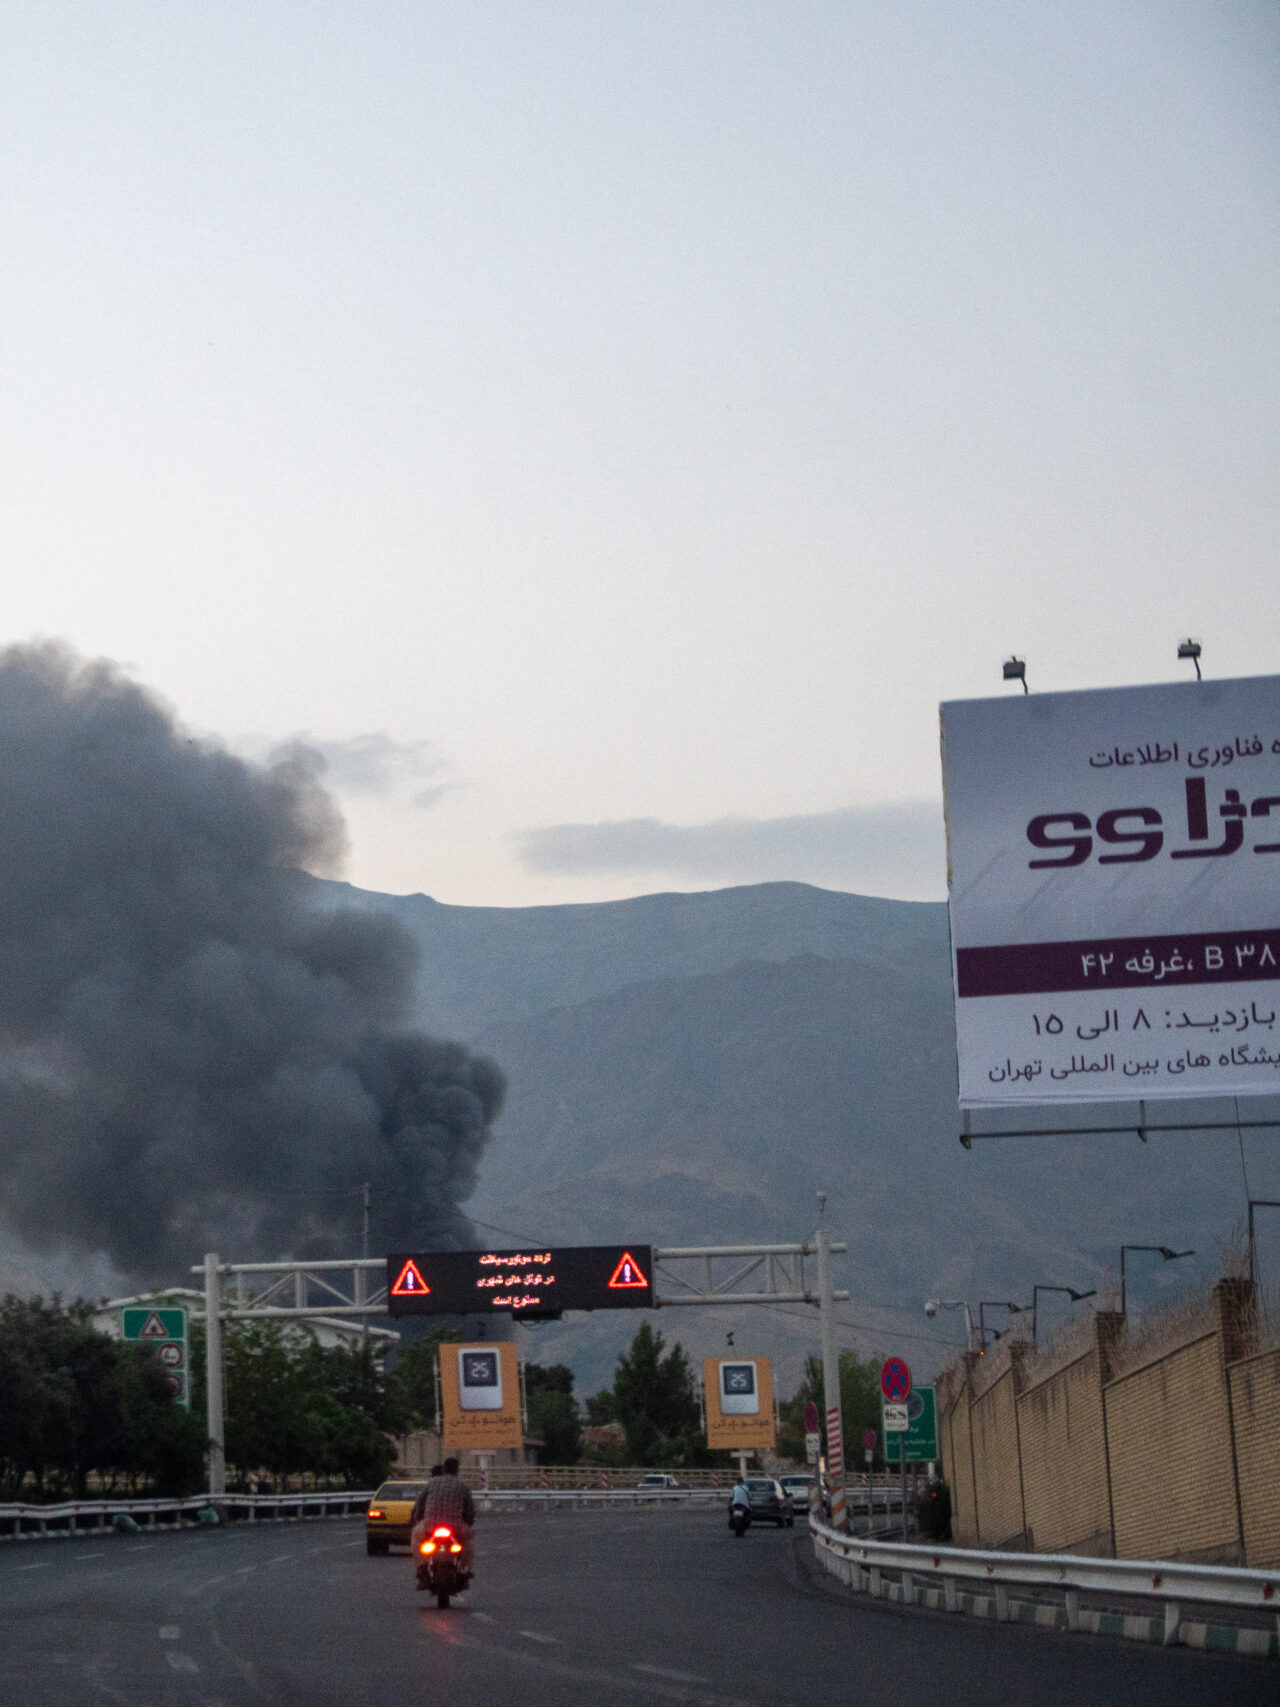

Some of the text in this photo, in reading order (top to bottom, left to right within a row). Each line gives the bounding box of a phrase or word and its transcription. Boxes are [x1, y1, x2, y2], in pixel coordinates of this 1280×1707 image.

[1089, 741, 1179, 768] اطلاعات
[1187, 734, 1264, 769] فناوری
[1081, 952, 1114, 977] ۴۲
[1204, 945, 1224, 970] B
[1032, 1001, 1276, 1040] بازدید: ۸ الی ۱۵
[989, 1058, 1042, 1082] تهران
[1050, 1053, 1115, 1080] المللی
[1123, 1059, 1159, 1076] بین
[1167, 1049, 1211, 1074] های
